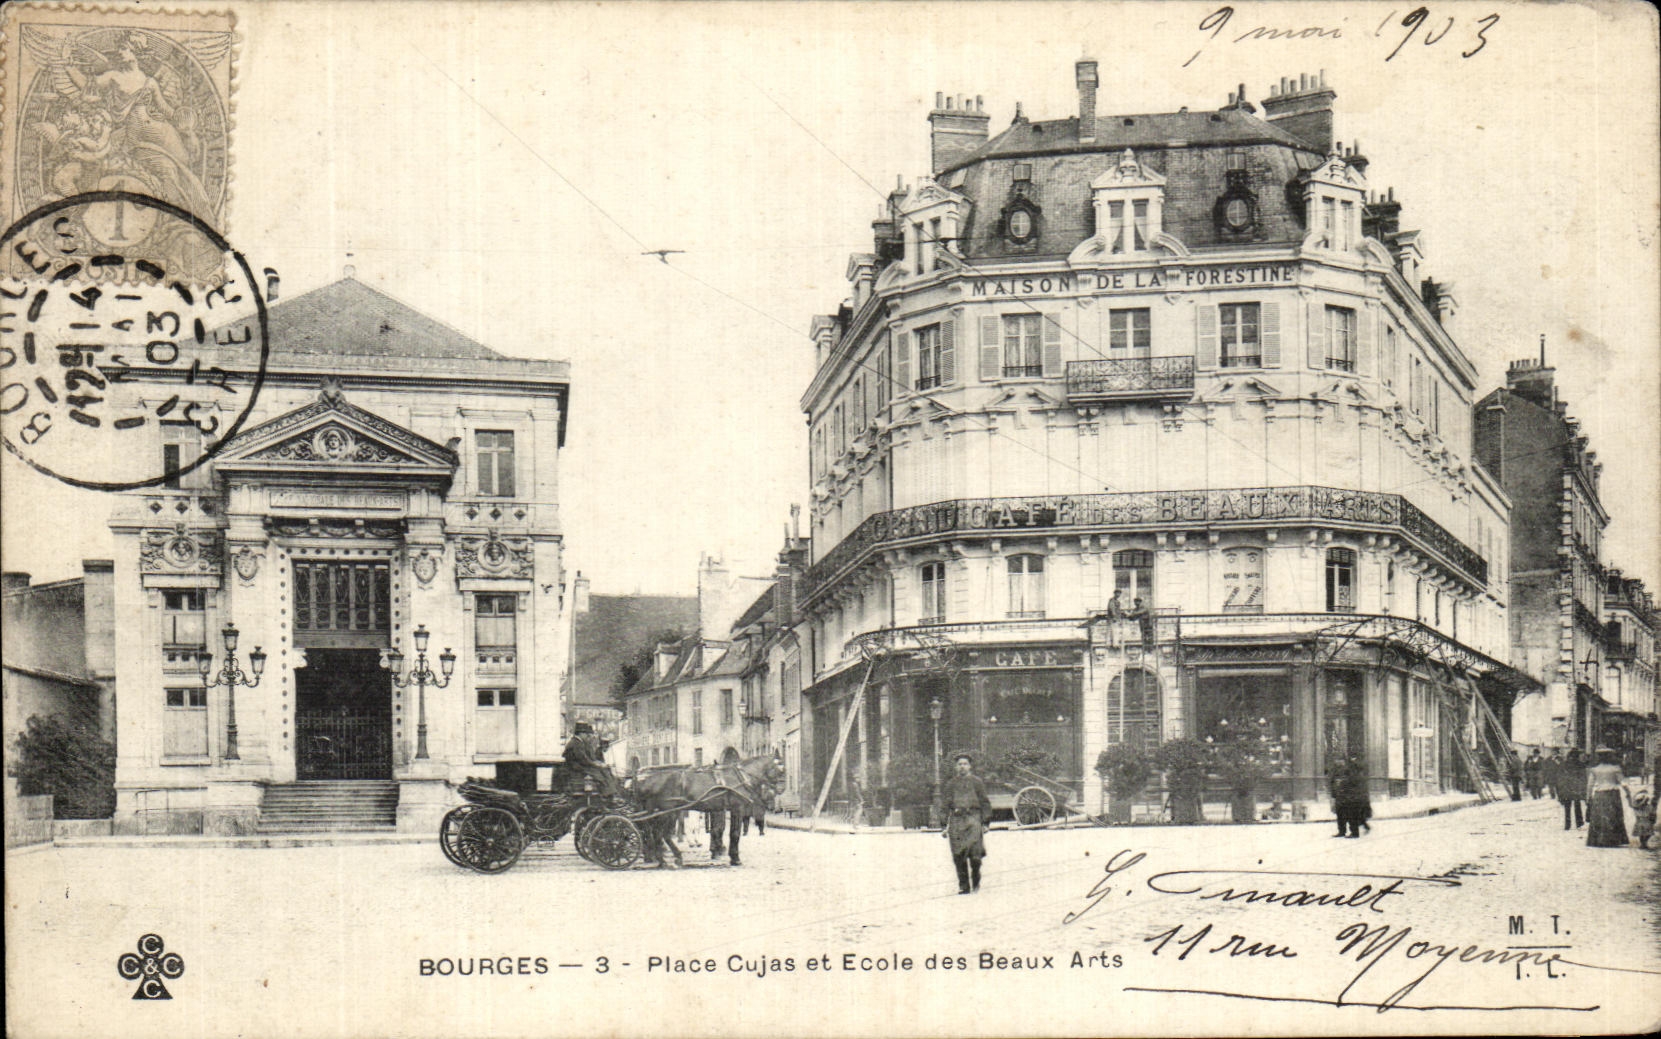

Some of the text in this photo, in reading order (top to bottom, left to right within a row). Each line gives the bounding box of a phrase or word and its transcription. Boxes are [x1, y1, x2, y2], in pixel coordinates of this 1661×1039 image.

[1182, 6, 1235, 68] 9
[1374, 6, 1501, 62] 1903
[971, 264, 1294, 297] MAISON DE LA FORESTINE
[869, 503, 957, 541] GRAND
[1091, 505, 1144, 527] DES
[1156, 492, 1300, 523] BEAUX
[1318, 497, 1397, 525] ARTS
[1144, 923, 1213, 960] 11
[1217, 933, 1298, 958] rue
